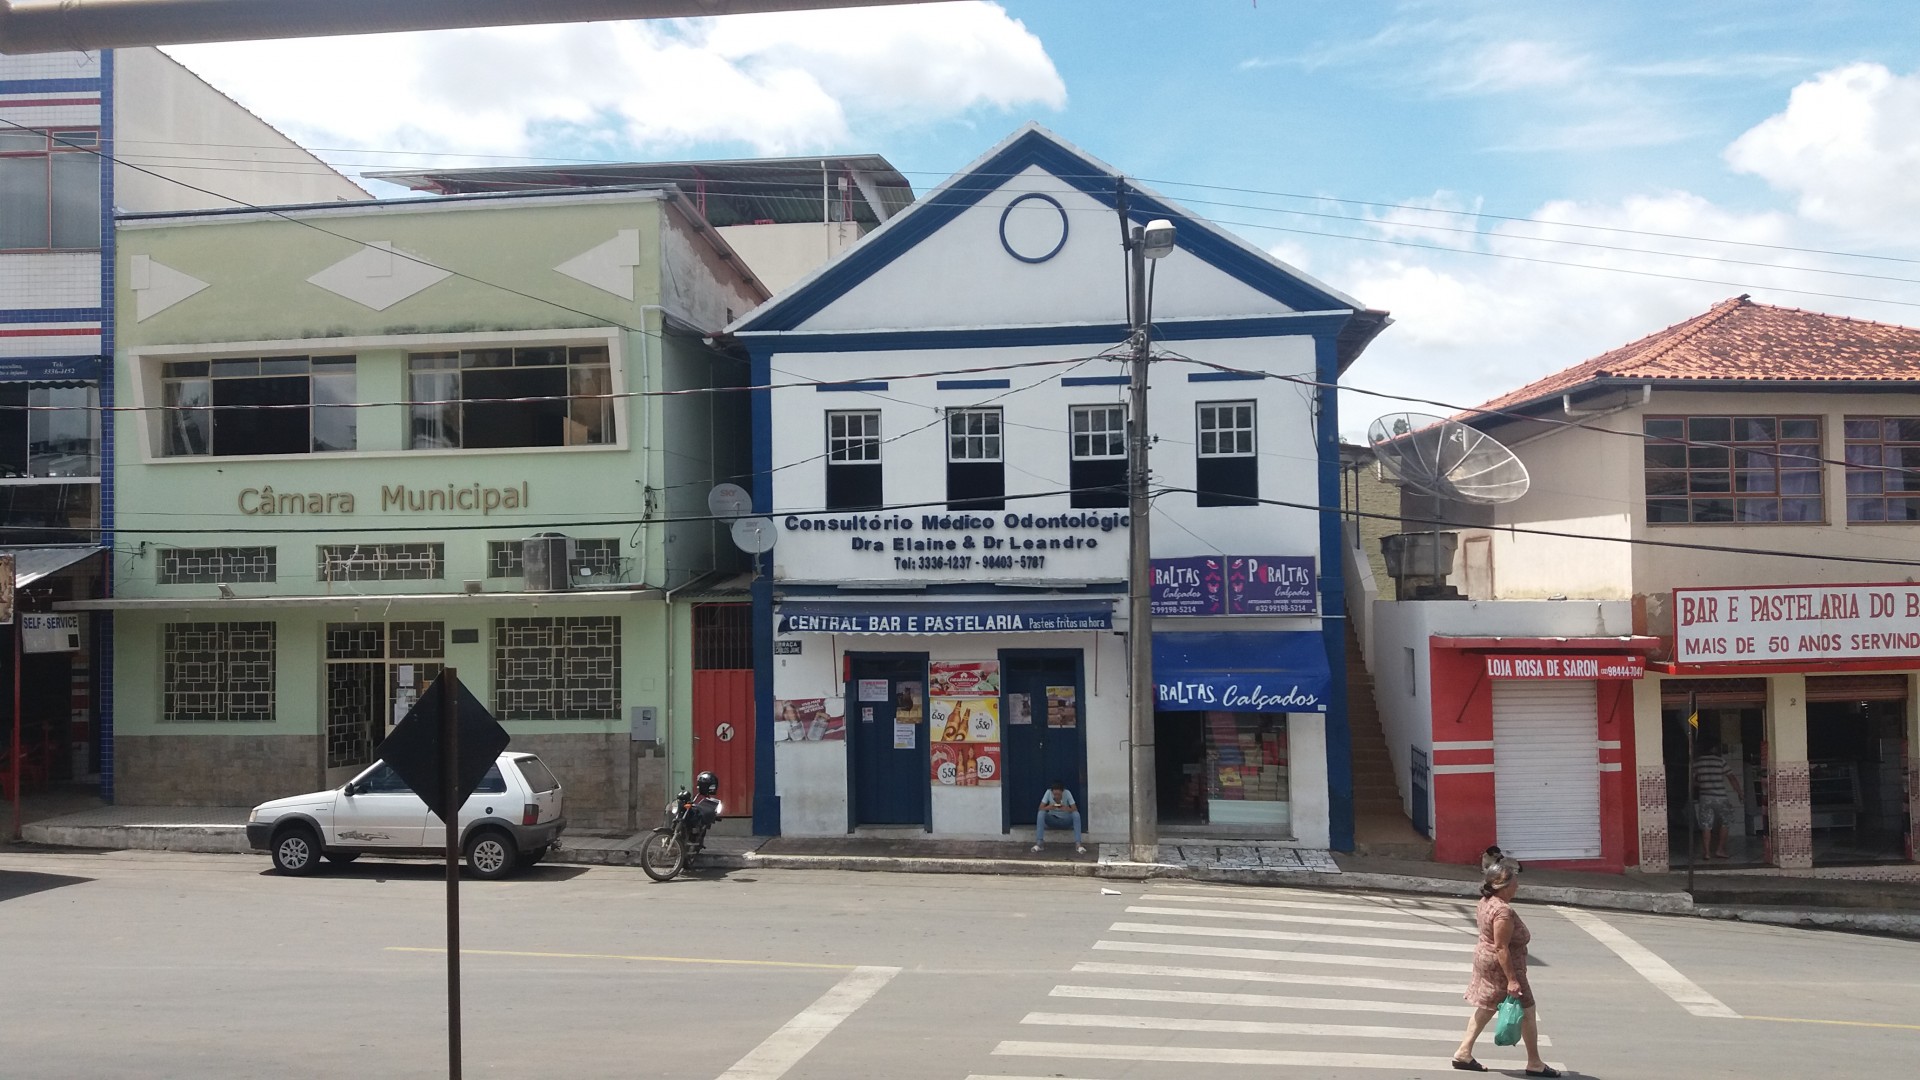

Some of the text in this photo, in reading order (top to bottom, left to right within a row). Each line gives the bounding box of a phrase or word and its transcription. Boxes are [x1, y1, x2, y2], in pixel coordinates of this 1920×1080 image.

[238, 481, 529, 516] Câmara Municipal
[785, 511, 1130, 532] Consultório Médico Odontológic
[851, 535, 1098, 552] Dra Elaine & Dr Leandro
[894, 556, 916, 570] Tel:
[918, 555, 972, 570] 3336-1237
[1151, 606, 1156, 614] 2
[1681, 592, 1920, 626] BAR E PASTELARIA DO B
[24, 617, 41, 629] SELF
[46, 616, 78, 629] SERVICE
[789, 616, 862, 631] CENTRAL
[869, 616, 901, 631] BAR
[907, 616, 918, 631] E
[924, 614, 1023, 631] PASTELARIA
[1088, 616, 1105, 628] hora
[1685, 637, 1727, 655] MAIS
[1735, 637, 1756, 654] DE
[1768, 636, 1790, 653] 50
[1798, 633, 1842, 652] ANOS
[1487, 659, 1512, 677] LOJA
[1515, 659, 1542, 677] ROSA
[1546, 659, 1560, 677] DE
[1563, 659, 1599, 677] SARON
[1222, 684, 1319, 710] Calçados
